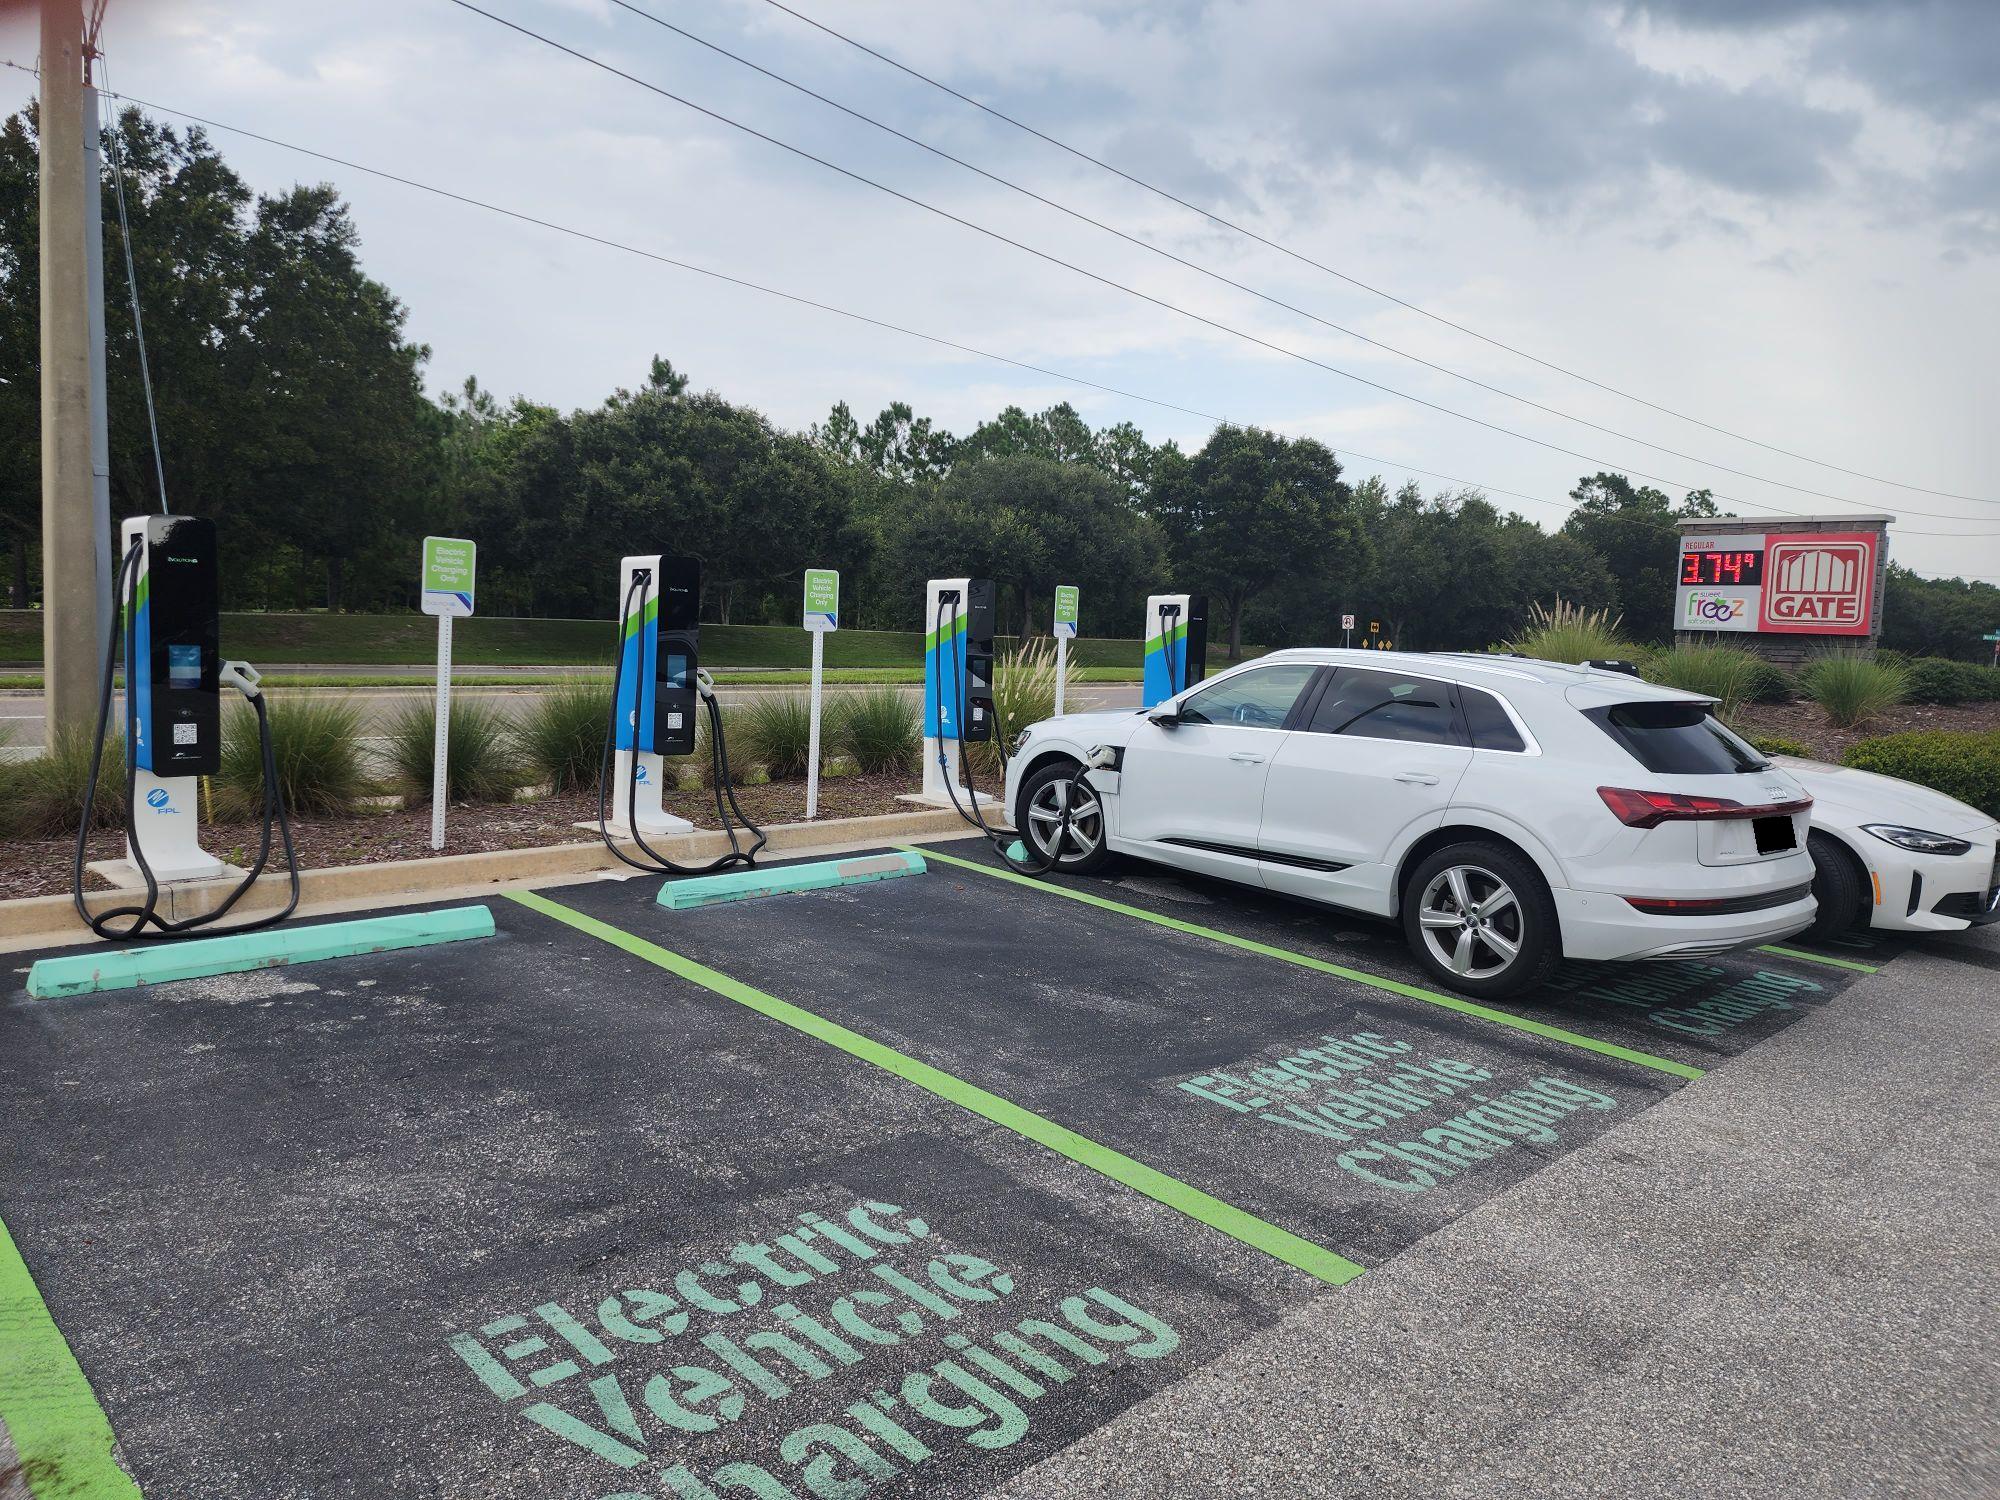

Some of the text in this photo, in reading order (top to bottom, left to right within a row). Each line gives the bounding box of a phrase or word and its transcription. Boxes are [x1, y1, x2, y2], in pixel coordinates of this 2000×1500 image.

[432, 565, 468, 576] Charging
[1685, 541, 1715, 549] REGULAR
[1774, 596, 1857, 619] GATE
[1649, 970, 1823, 1035] Charging
[1177, 1032, 1414, 1113] Electric
[1259, 1059, 1493, 1141] Vehicle
[1336, 1077, 1617, 1193] Charging
[449, 1202, 931, 1401] Electric
[521, 1253, 1015, 1470] Vehicle
[596, 1287, 1182, 1500] harging
